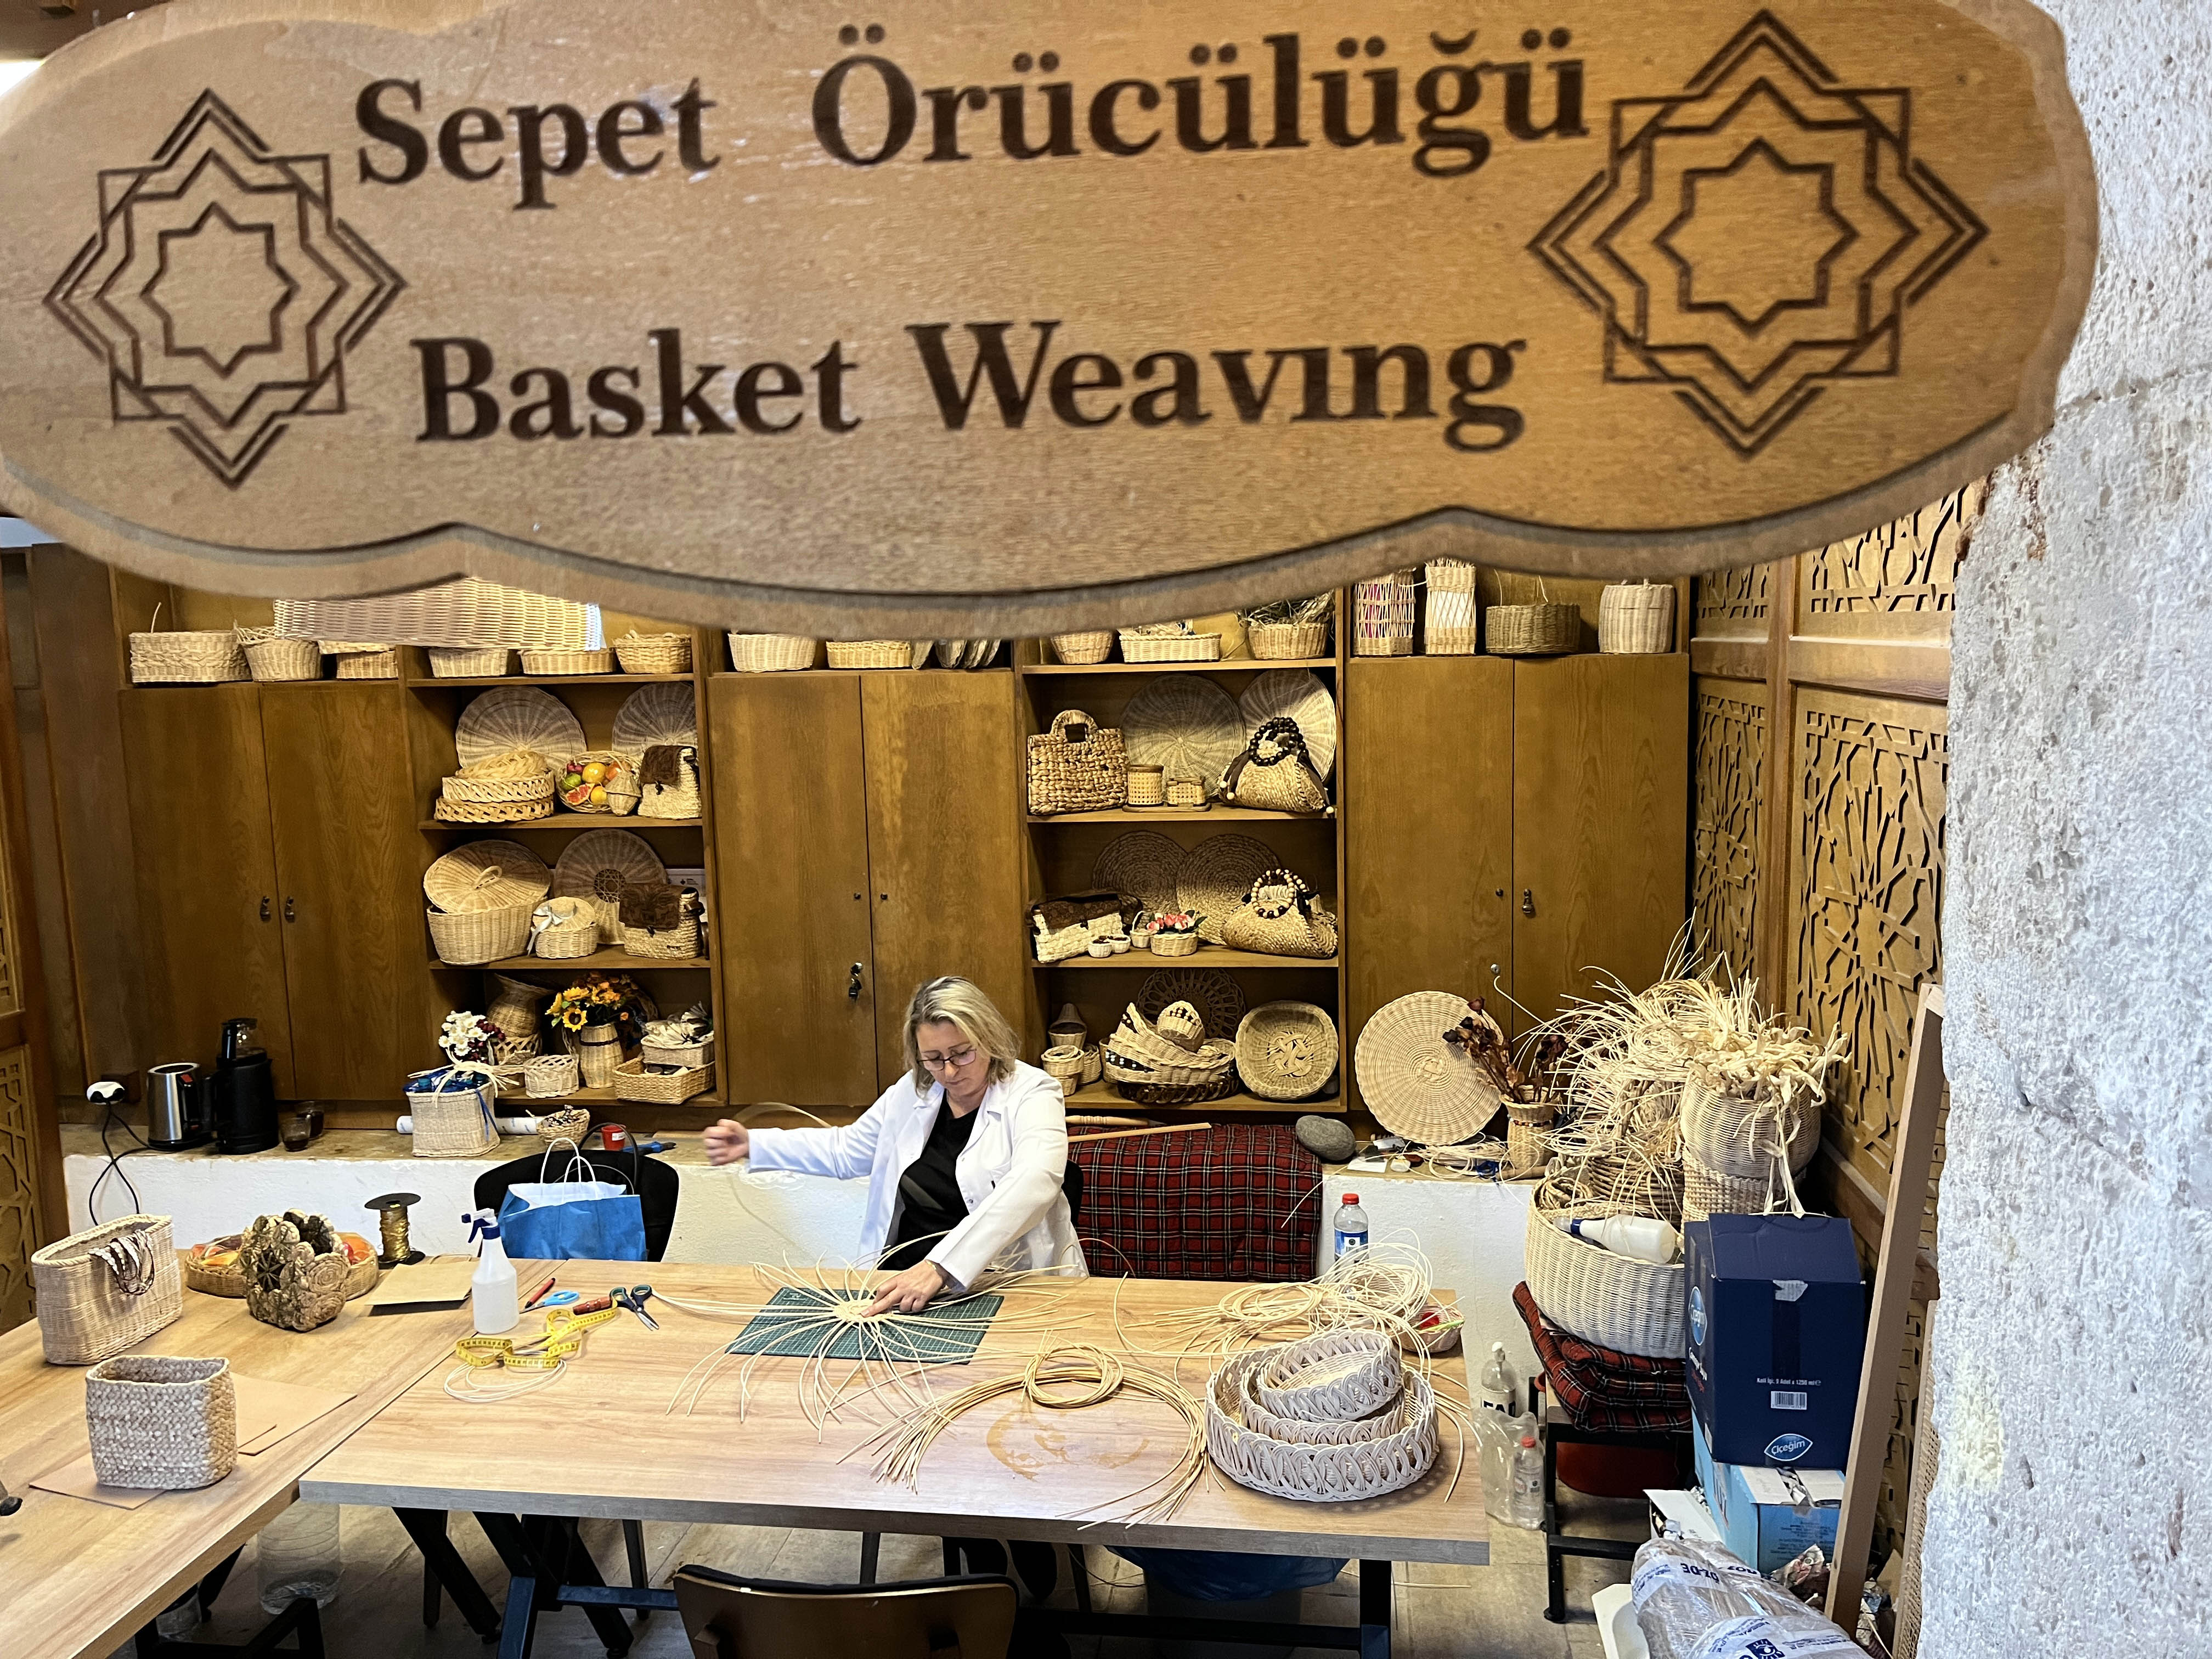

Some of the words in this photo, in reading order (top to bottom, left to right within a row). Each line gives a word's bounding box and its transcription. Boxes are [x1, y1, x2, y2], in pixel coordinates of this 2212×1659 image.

[356, 78, 721, 211] Sepet
[812, 24, 1591, 178] Örücülüğü
[409, 328, 863, 443] Basket
[1771, 1440, 1805, 1455] Çiçeğim
